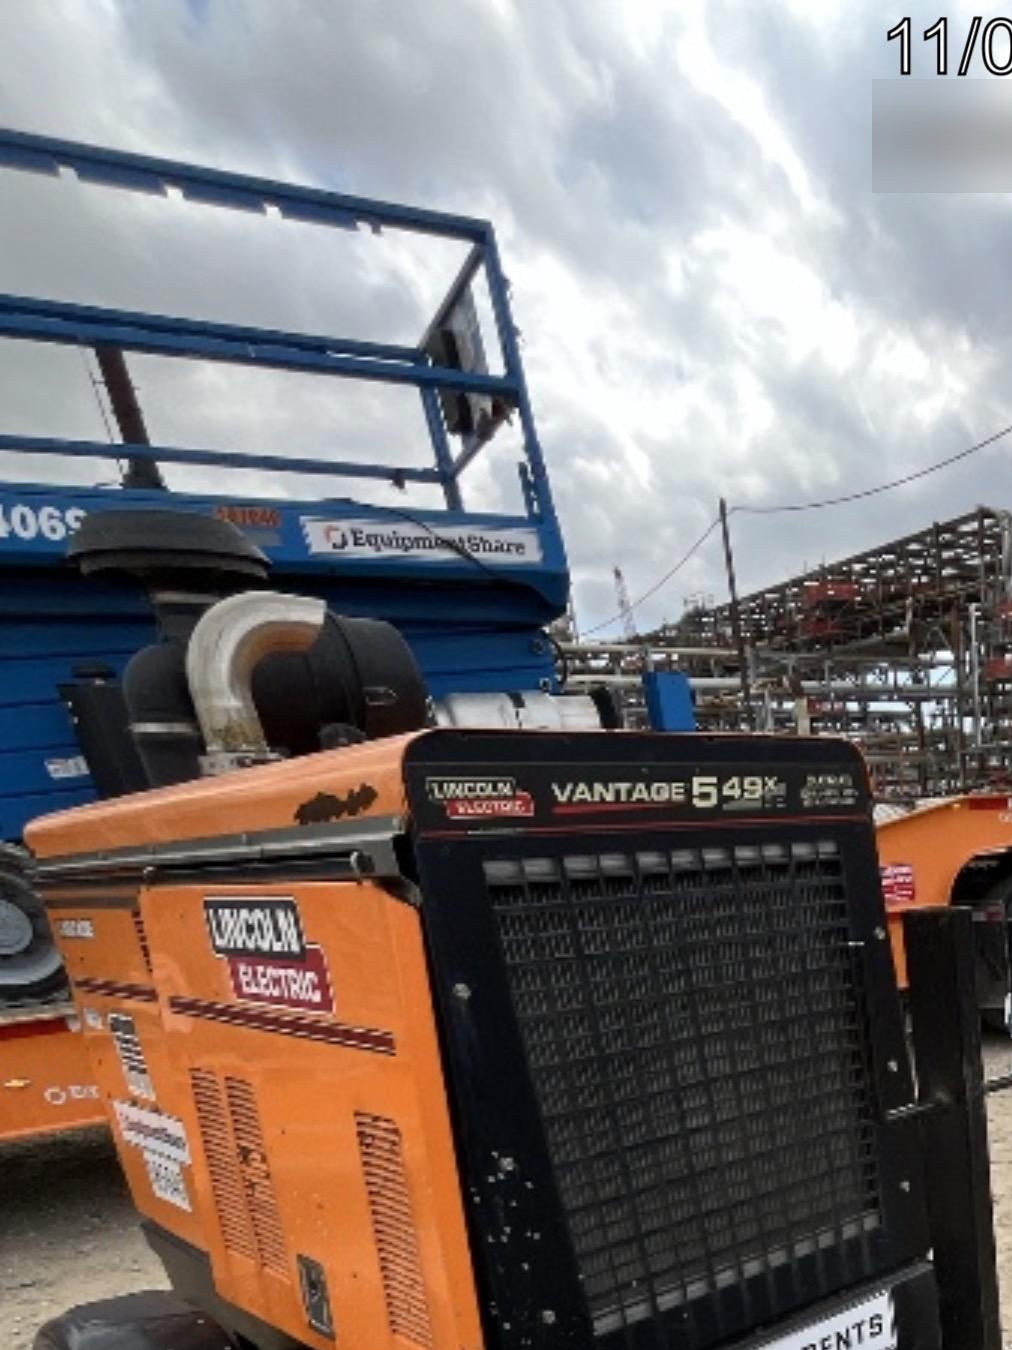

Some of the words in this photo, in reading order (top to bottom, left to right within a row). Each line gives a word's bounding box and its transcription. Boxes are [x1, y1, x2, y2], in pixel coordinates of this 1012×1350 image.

[431, 782, 514, 799] LINCOLN
[552, 781, 686, 803] VANTAGE
[208, 907, 301, 955] LINCOLN
[238, 962, 322, 1003] ELECTRIC
